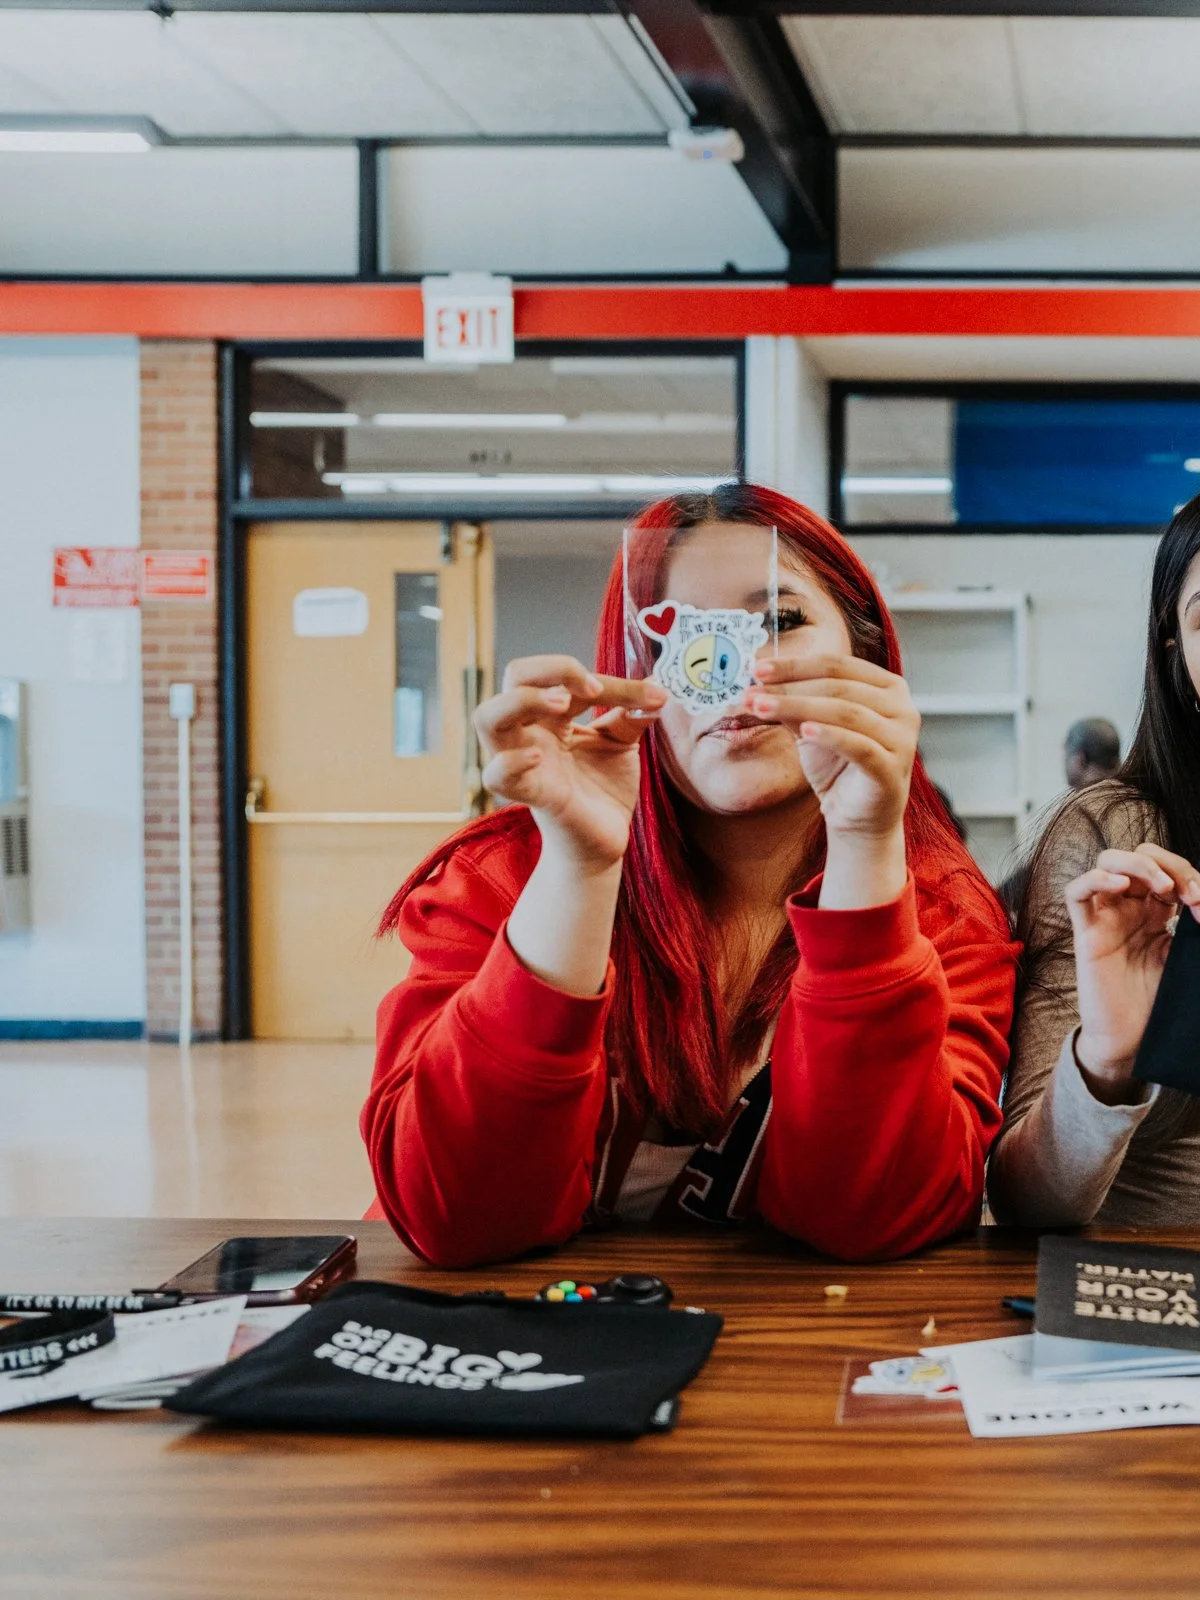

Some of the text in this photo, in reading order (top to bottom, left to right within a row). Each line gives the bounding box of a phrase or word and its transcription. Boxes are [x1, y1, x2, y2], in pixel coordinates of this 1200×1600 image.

[436, 306, 500, 350] EXIT
[1076, 1279, 1198, 1306] YOUR
[1074, 1301, 1200, 1328] WRITE
[342, 1320, 392, 1343] BAG
[313, 1342, 487, 1391] FEELINGS
[331, 1331, 504, 1380] OF BIG
[983, 1402, 1194, 1425] WELCOME
